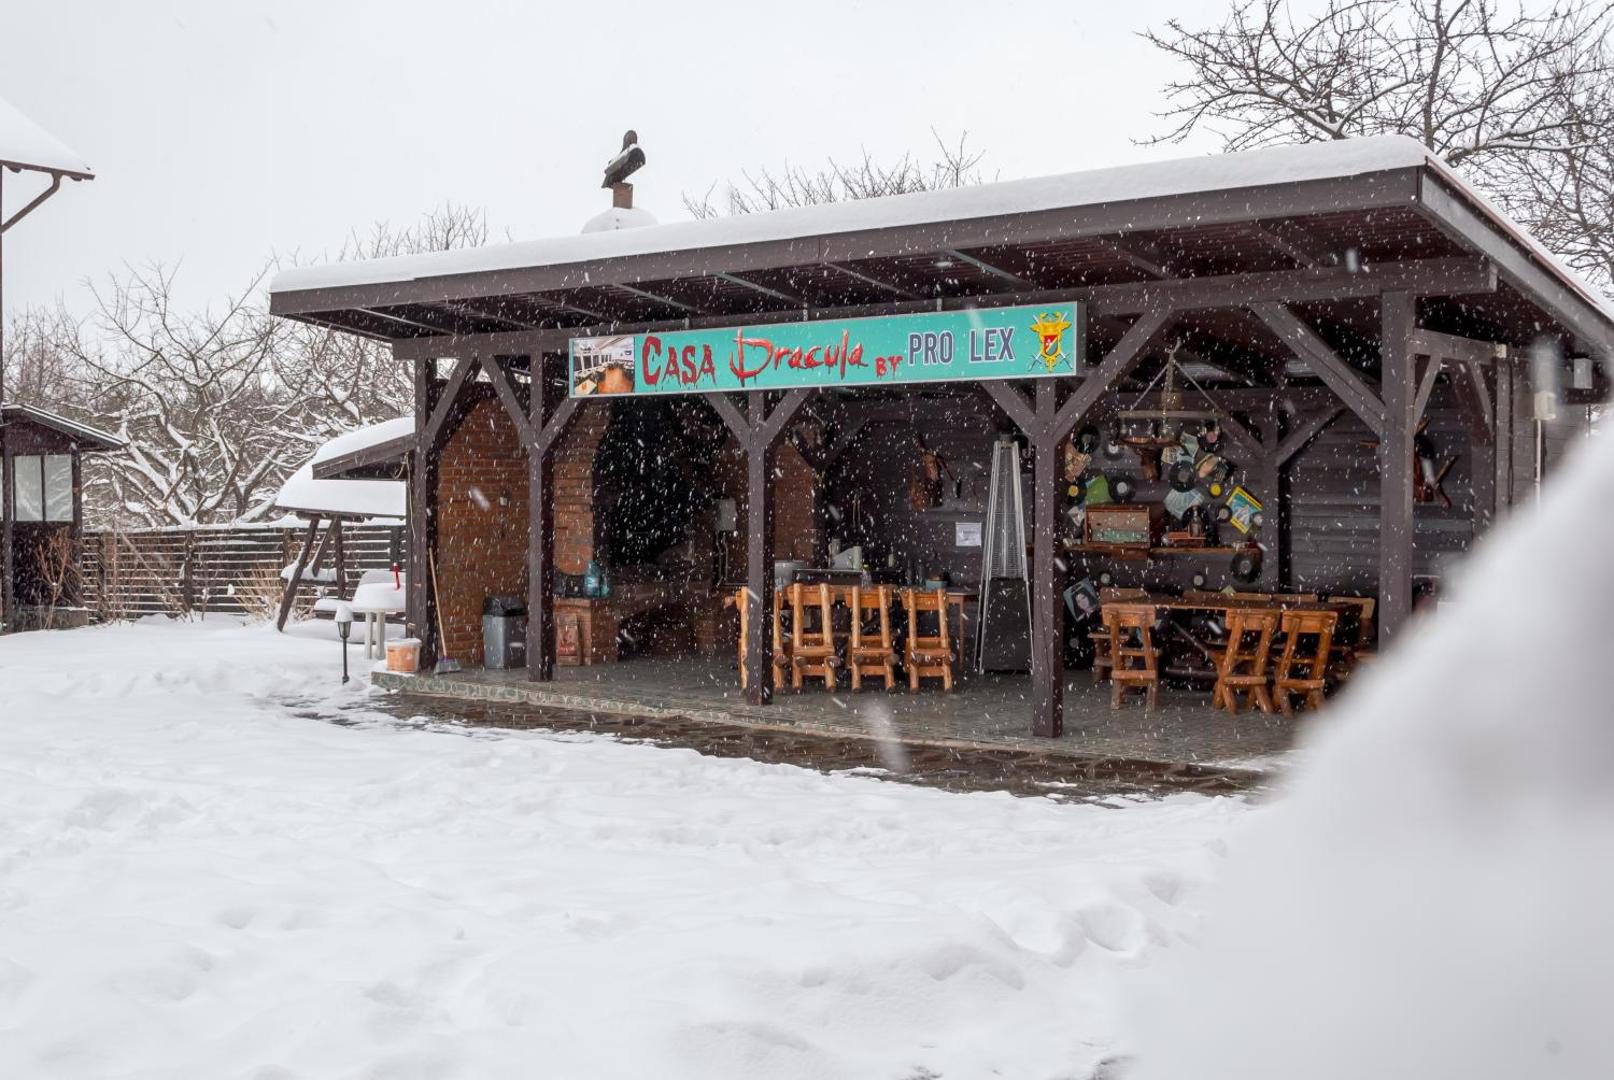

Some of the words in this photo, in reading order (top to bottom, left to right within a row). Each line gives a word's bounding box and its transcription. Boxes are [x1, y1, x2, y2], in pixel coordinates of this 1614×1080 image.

[642, 335, 717, 389] CASA
[729, 327, 868, 387] Dracula
[874, 355, 903, 379] BY
[908, 331, 954, 366] PRO
[969, 326, 1015, 363] LEX
